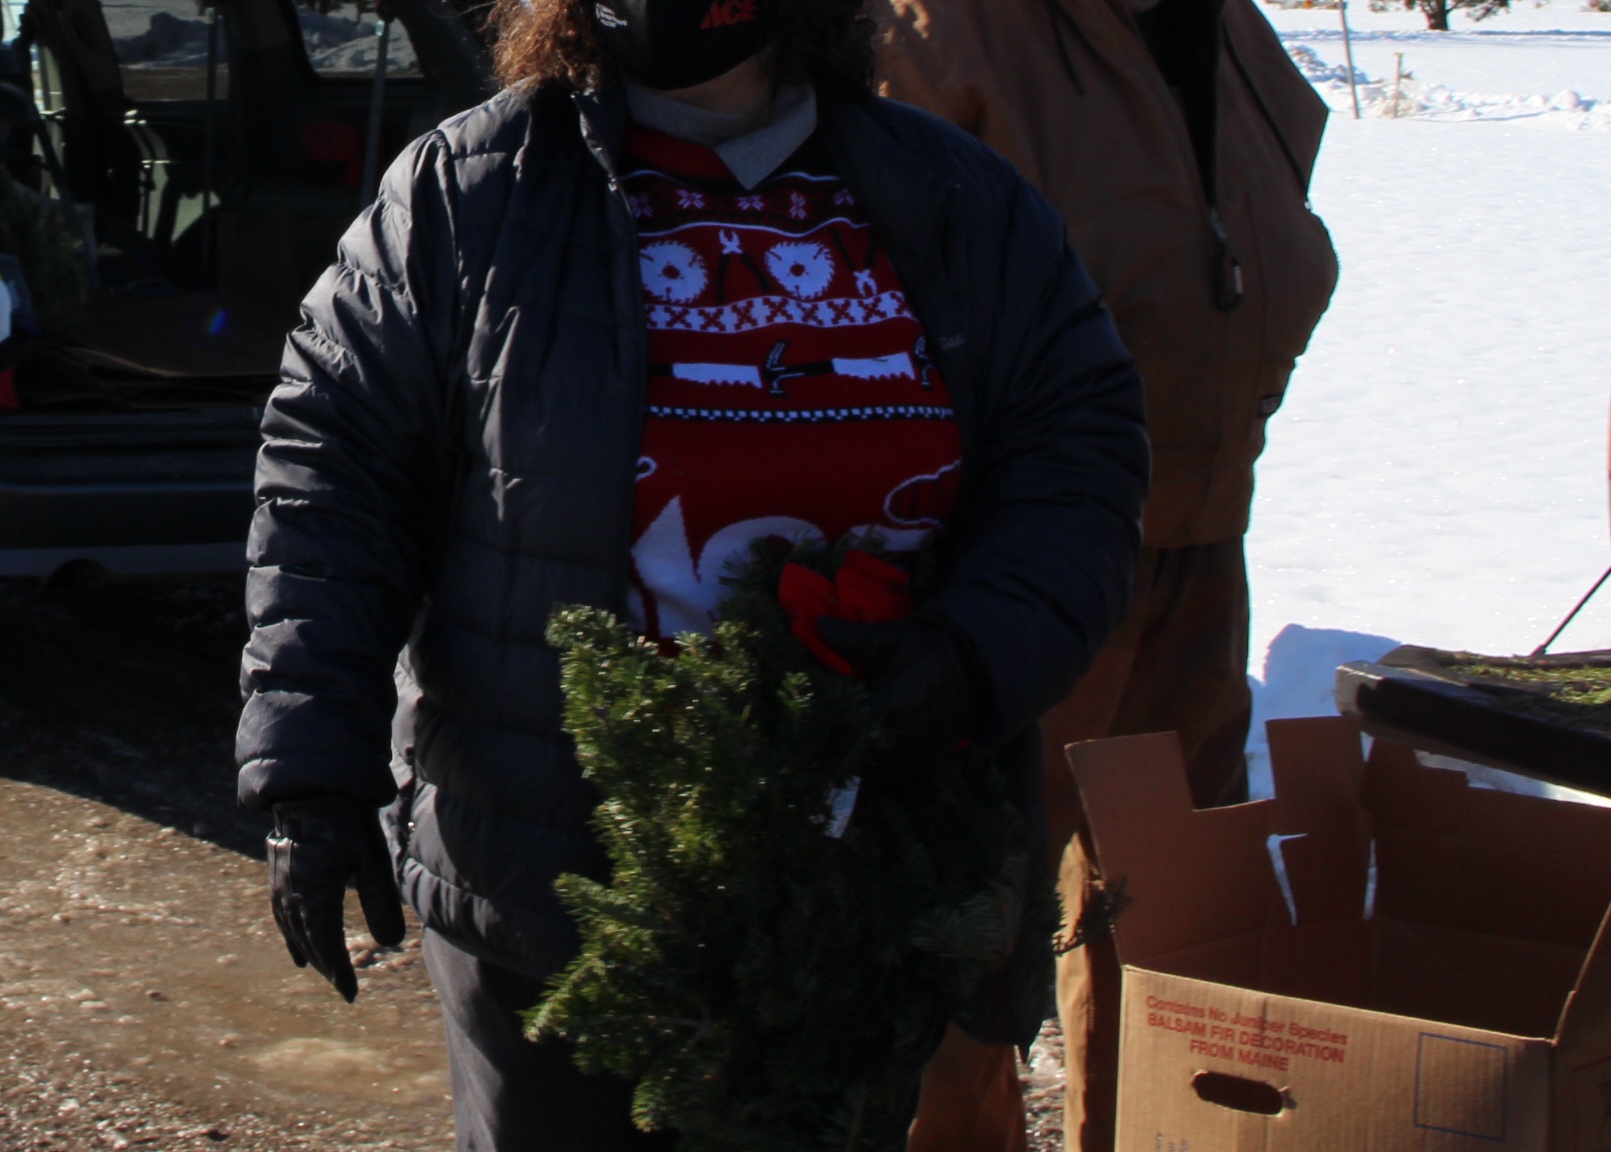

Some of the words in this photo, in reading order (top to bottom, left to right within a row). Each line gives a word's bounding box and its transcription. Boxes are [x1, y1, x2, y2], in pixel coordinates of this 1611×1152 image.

[1146, 995, 1205, 1019] Contains
[1209, 1007, 1227, 1022] No
[1231, 1012, 1286, 1034] Juniper
[1289, 1022, 1348, 1046] Species
[1147, 1012, 1207, 1036] BALSAM
[1211, 1025, 1236, 1043] FIR
[1239, 1031, 1345, 1064] DECORATION
[1190, 1039, 1234, 1060] FROM
[1238, 1050, 1290, 1072] MAINE
